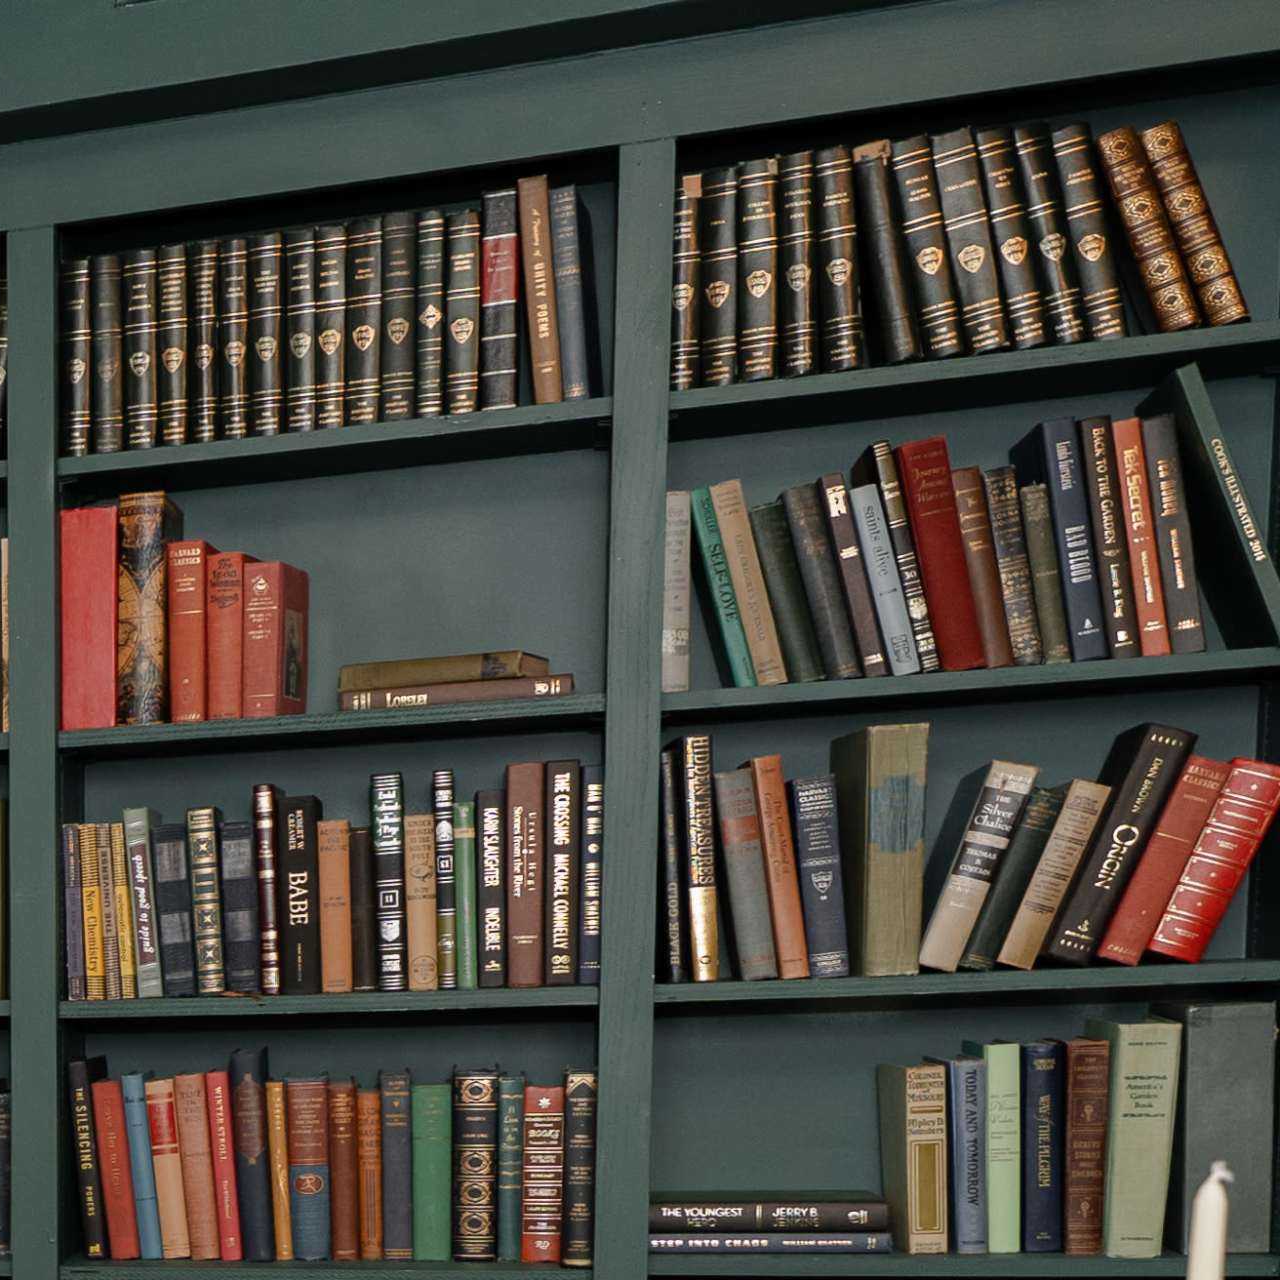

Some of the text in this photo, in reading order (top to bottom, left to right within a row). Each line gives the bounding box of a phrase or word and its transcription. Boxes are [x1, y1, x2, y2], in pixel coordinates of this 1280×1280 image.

[533, 261, 550, 338] UNITY POEMS
[1091, 427, 1117, 544] BACK TO THE GARDEN
[1121, 446, 1147, 530] Tek Secret
[1209, 437, 1259, 539] COOK'S ILLUSTRATED
[862, 504, 891, 576] saints alive
[1065, 525, 1093, 583] BAD BLOOD
[553, 772, 570, 845] THE CROSSING
[693, 736, 715, 884] HIDDEN TREASURES
[982, 803, 1014, 819] Silver
[1130, 755, 1163, 815] DAN BROWN
[287, 813, 296, 849] CREAMER
[295, 809, 304, 836] ROBERT
[483, 807, 499, 887] KARIN SLAUGHTER
[512, 805, 523, 897] Stones from the River
[527, 811, 535, 891] Ursula Hegi
[965, 848, 997, 861] THOMAS
[974, 815, 1013, 833] Chalice
[1094, 820, 1140, 894] ORIGIN
[132, 853, 154, 953] guide to good speech
[288, 871, 308, 925] BABE
[552, 853, 568, 949] MICHAEL CONNELLY
[584, 861, 599, 897] WILLIAM
[84, 889, 98, 972] New Chemistry
[484, 906, 500, 951] INDELIBLE
[666, 881, 681, 964] BLACK GOLD
[73, 1087, 93, 1170] THE SILENCING
[211, 1085, 229, 1160] WINTER STROLL
[528, 1129, 560, 1138] BOOKS
[964, 1069, 979, 1206] TODAY AND TOMORROW
[1038, 1094, 1050, 1114] WAY
[84, 1185, 95, 1216] POWERS
[1038, 1144, 1050, 1187] PILGRIM
[661, 1208, 744, 1217] THE YOUNGEST
[772, 1208, 808, 1217] JERRY
